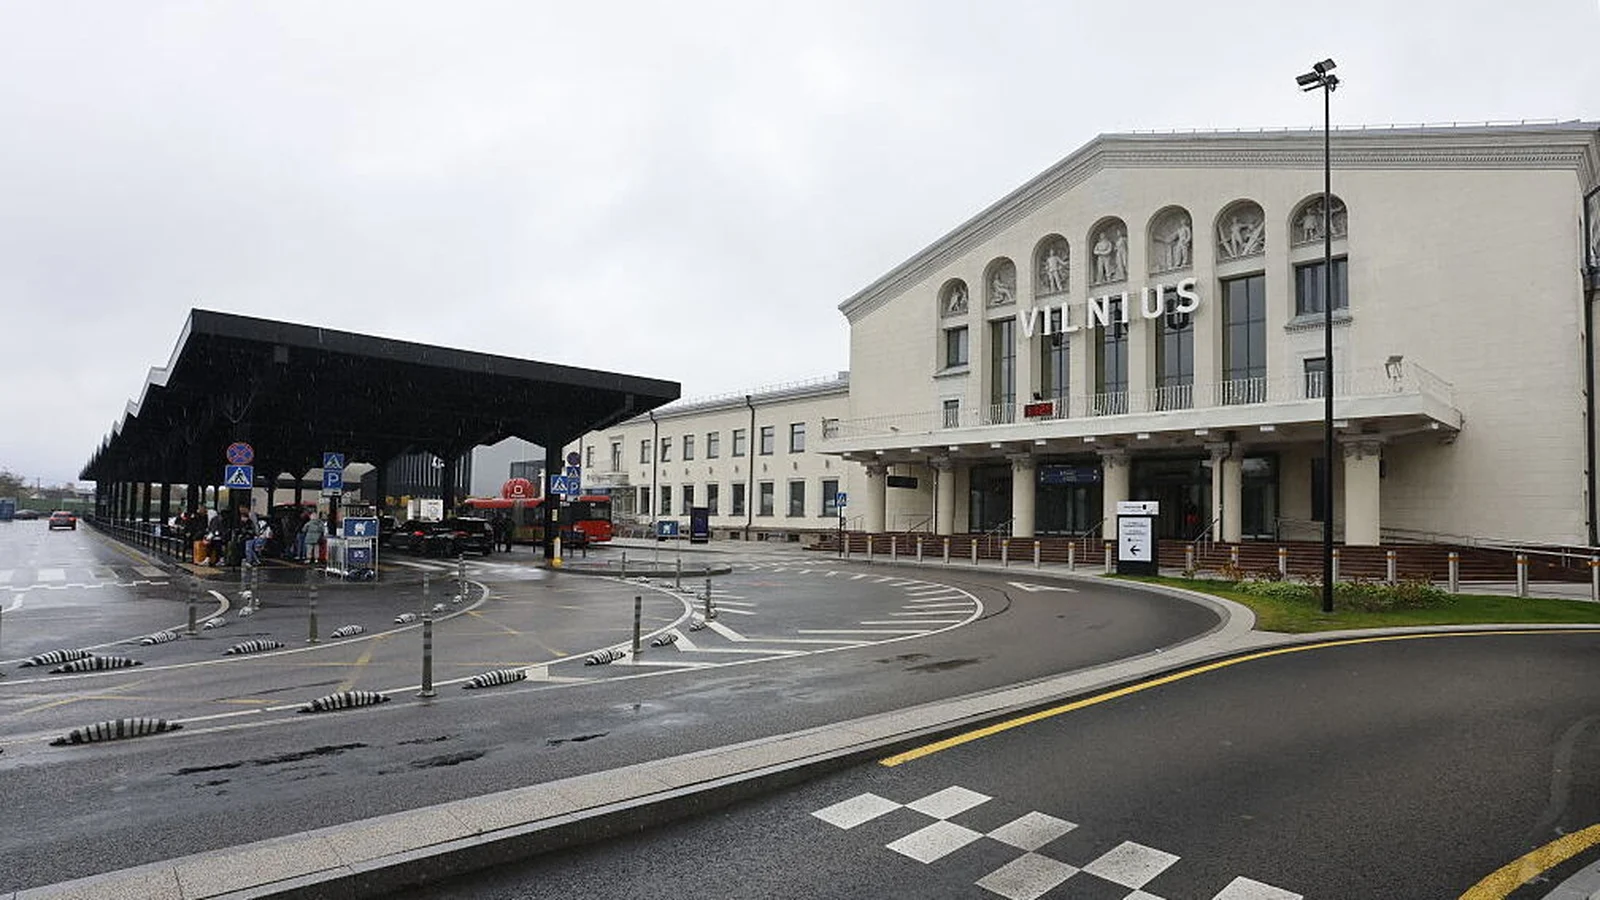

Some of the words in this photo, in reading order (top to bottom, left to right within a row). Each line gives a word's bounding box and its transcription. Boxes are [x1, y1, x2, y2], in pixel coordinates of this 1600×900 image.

[1020, 277, 1200, 338] VILNIUS
[328, 473, 339, 486] P
[571, 482, 579, 493] P
